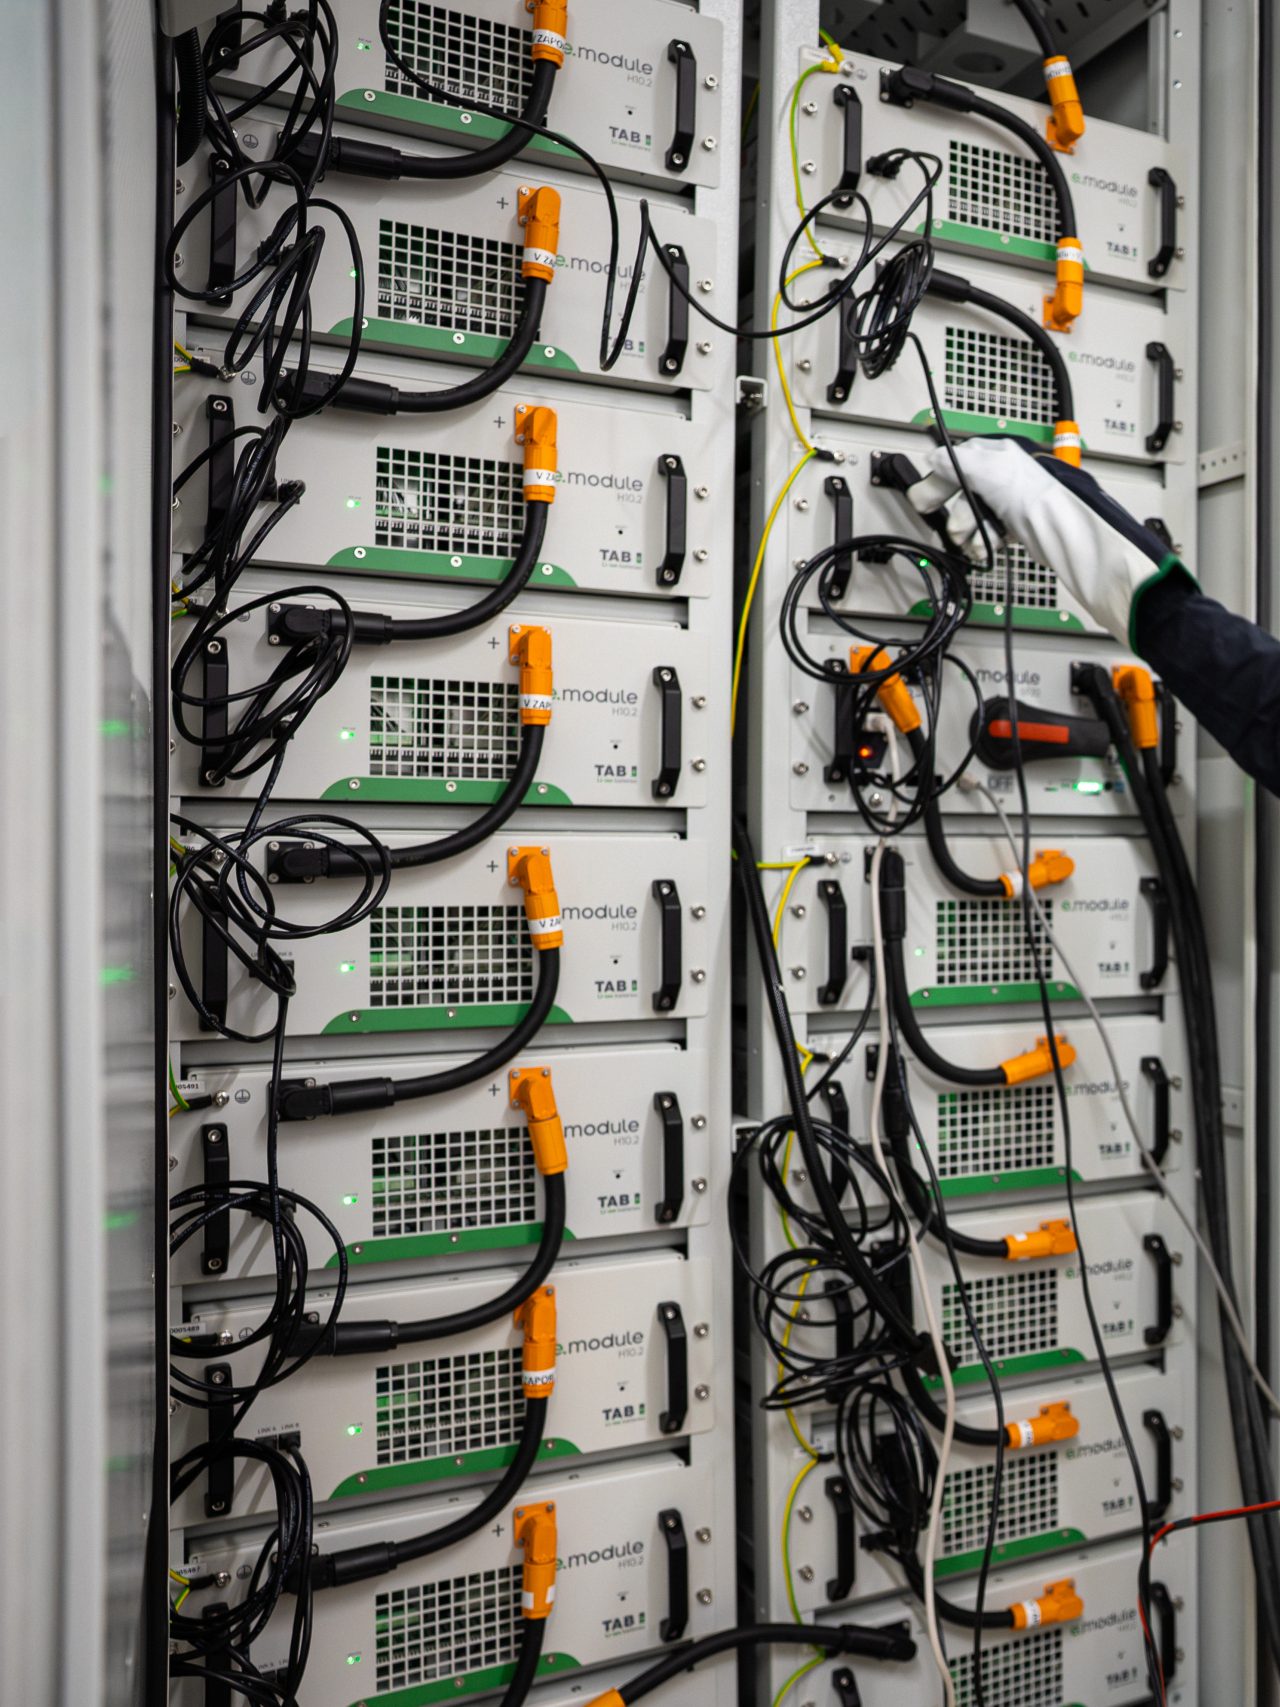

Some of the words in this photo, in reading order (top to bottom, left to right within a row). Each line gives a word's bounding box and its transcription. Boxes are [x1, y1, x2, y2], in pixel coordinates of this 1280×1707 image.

[563, 43, 653, 75] e.module
[609, 126, 641, 143] TAB
[554, 470, 643, 492] e.module
[600, 549, 631, 562] TAB
[594, 765, 627, 777] TAB
[562, 904, 638, 920] module
[594, 980, 627, 993] TAB
[564, 1119, 639, 1138] module
[597, 1194, 630, 1208] TAB
[555, 1331, 643, 1356] e.module
[602, 1405, 635, 1421] TAB
[602, 1615, 635, 1632] TAB
